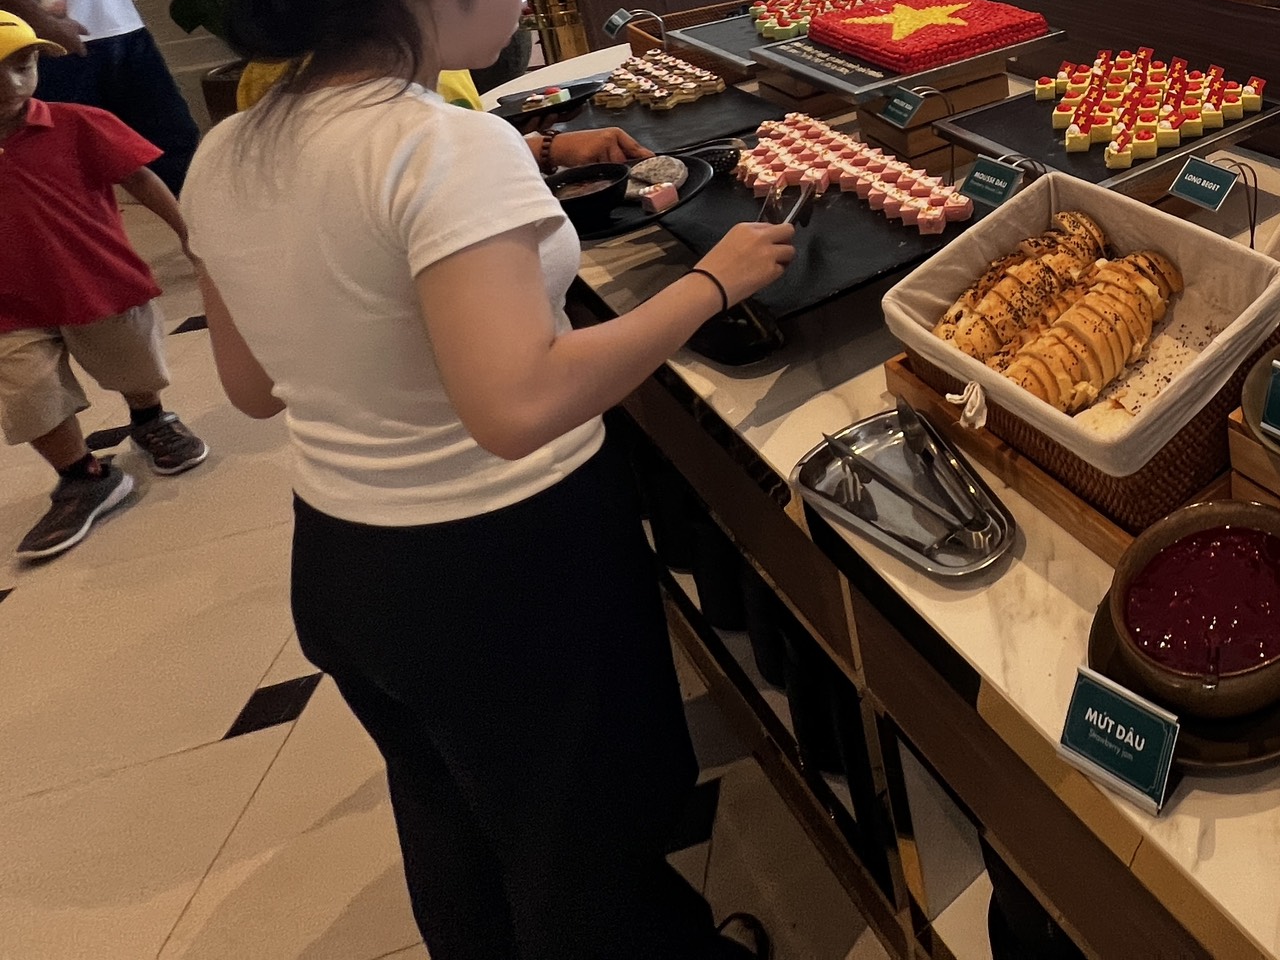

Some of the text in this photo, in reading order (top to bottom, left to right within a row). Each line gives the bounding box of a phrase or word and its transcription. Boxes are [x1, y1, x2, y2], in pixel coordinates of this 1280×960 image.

[1184, 173, 1202, 185] LONG
[1085, 707, 1145, 751] MỨT DÂU
